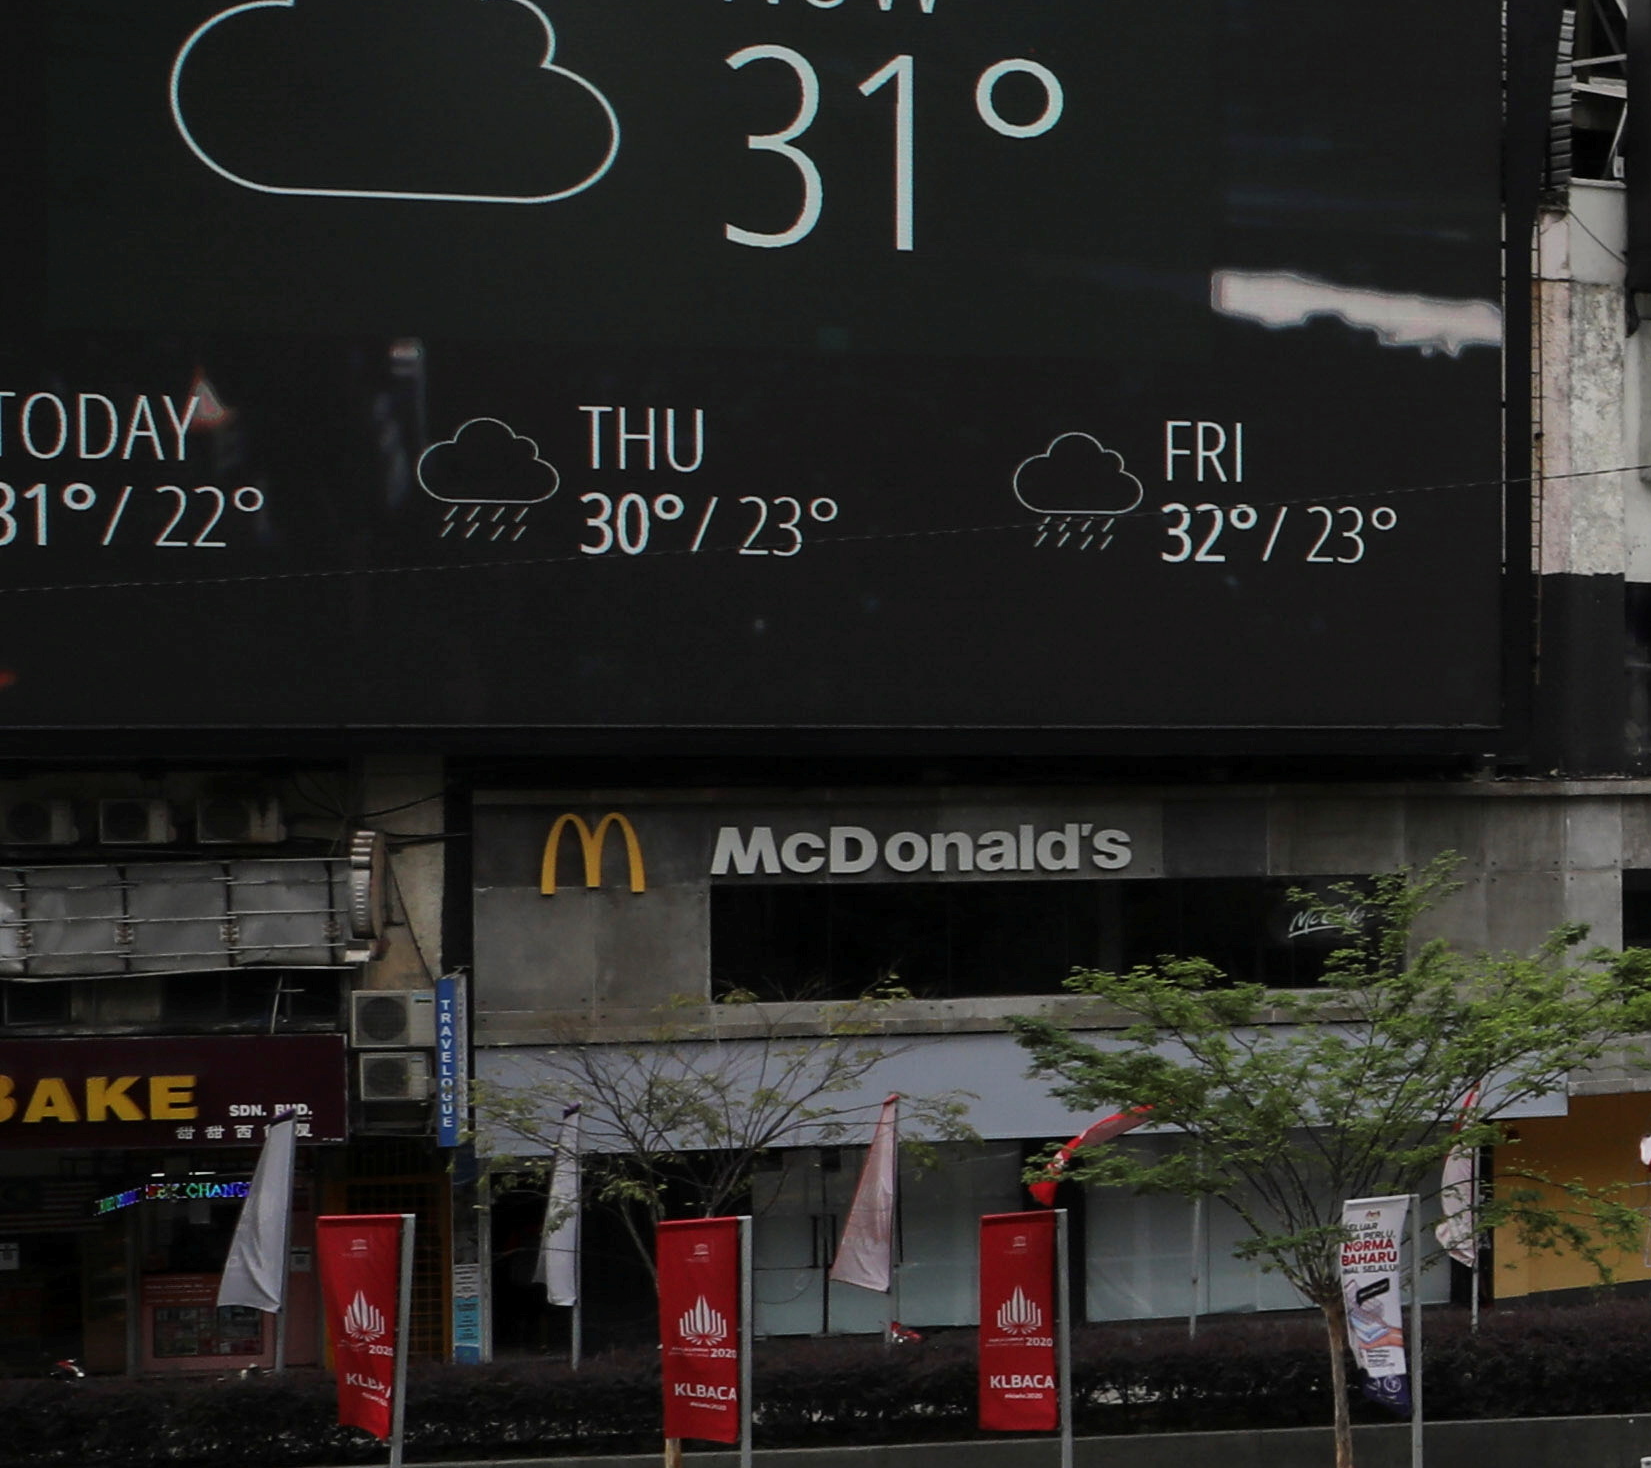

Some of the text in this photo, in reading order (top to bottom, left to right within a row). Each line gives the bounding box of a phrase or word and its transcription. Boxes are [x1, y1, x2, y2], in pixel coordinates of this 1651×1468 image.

[724, 42, 1064, 252] 31°
[579, 406, 705, 472] THU
[1165, 422, 1244, 483] FRI
[739, 496, 838, 556] 23°
[1306, 506, 1397, 566] 23°
[711, 822, 1132, 876] McDonald's
[440, 999, 454, 1129] TRAVELOGUE
[229, 1104, 267, 1117] SDN.
[1341, 1251, 1397, 1266] BAHARU
[1344, 1238, 1395, 1254] NORMA
[710, 1348, 737, 1359] 2020
[1026, 1337, 1053, 1347] 2020
[674, 1383, 738, 1401] KLBACA
[990, 1374, 1055, 1389] KLBACA
